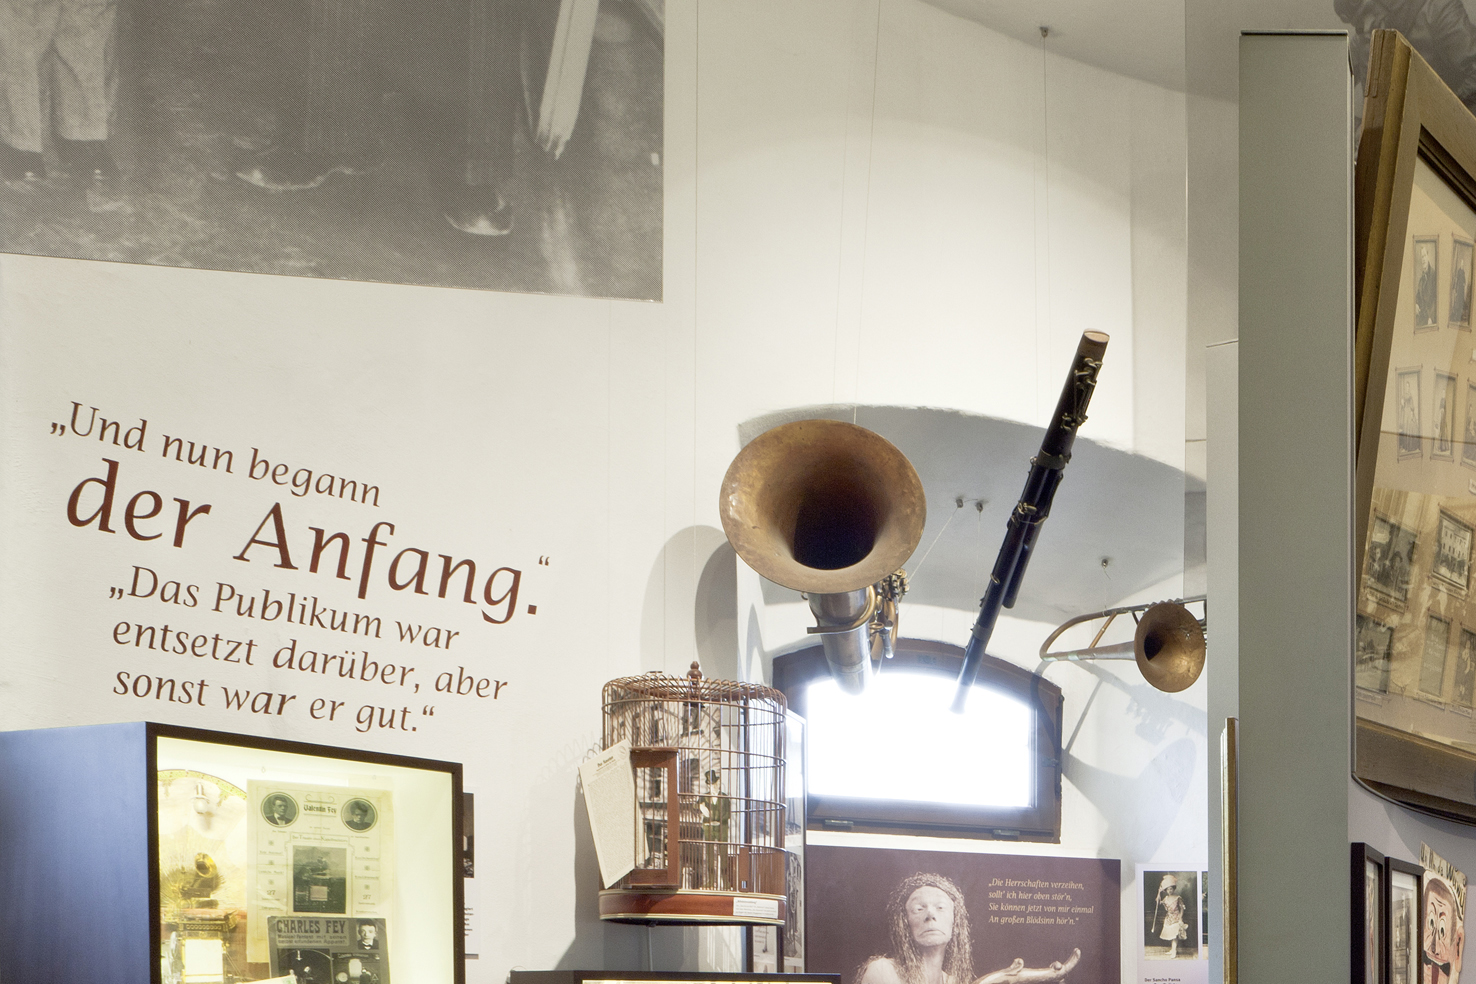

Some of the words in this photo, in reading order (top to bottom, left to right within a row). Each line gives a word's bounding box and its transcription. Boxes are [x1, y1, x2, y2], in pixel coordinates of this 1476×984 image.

[50, 401, 147, 452] „Und
[161, 433, 235, 473] nun
[248, 447, 381, 507] begann
[66, 457, 212, 549] der
[233, 501, 550, 624] Anfang.“
[109, 565, 200, 608] „Das
[211, 581, 383, 639] Publikum
[394, 619, 460, 650] war
[112, 620, 258, 666] entsetzt
[272, 639, 421, 692] darüber,
[434, 665, 508, 700] aber
[113, 669, 209, 707] sonst
[222, 685, 297, 717] war
[310, 694, 345, 722] er
[356, 704, 435, 733] gut.“
[1005, 878, 1049, 889] Herrschaften
[1006, 891, 1016, 899] ich
[1018, 891, 1032, 899] hier
[1033, 892, 1050, 900] oben
[276, 920, 321, 934] CHARLES
[325, 920, 346, 934] FEY
[988, 903, 999, 911] Sie
[1000, 903, 1025, 912] können
[1026, 904, 1042, 913] jetzt
[1057, 905, 1069, 913] mir
[1071, 905, 1094, 914] einmal
[988, 915, 999, 923] An
[1000, 915, 1025, 925] großen
[1026, 915, 1055, 925] Blödsinn
